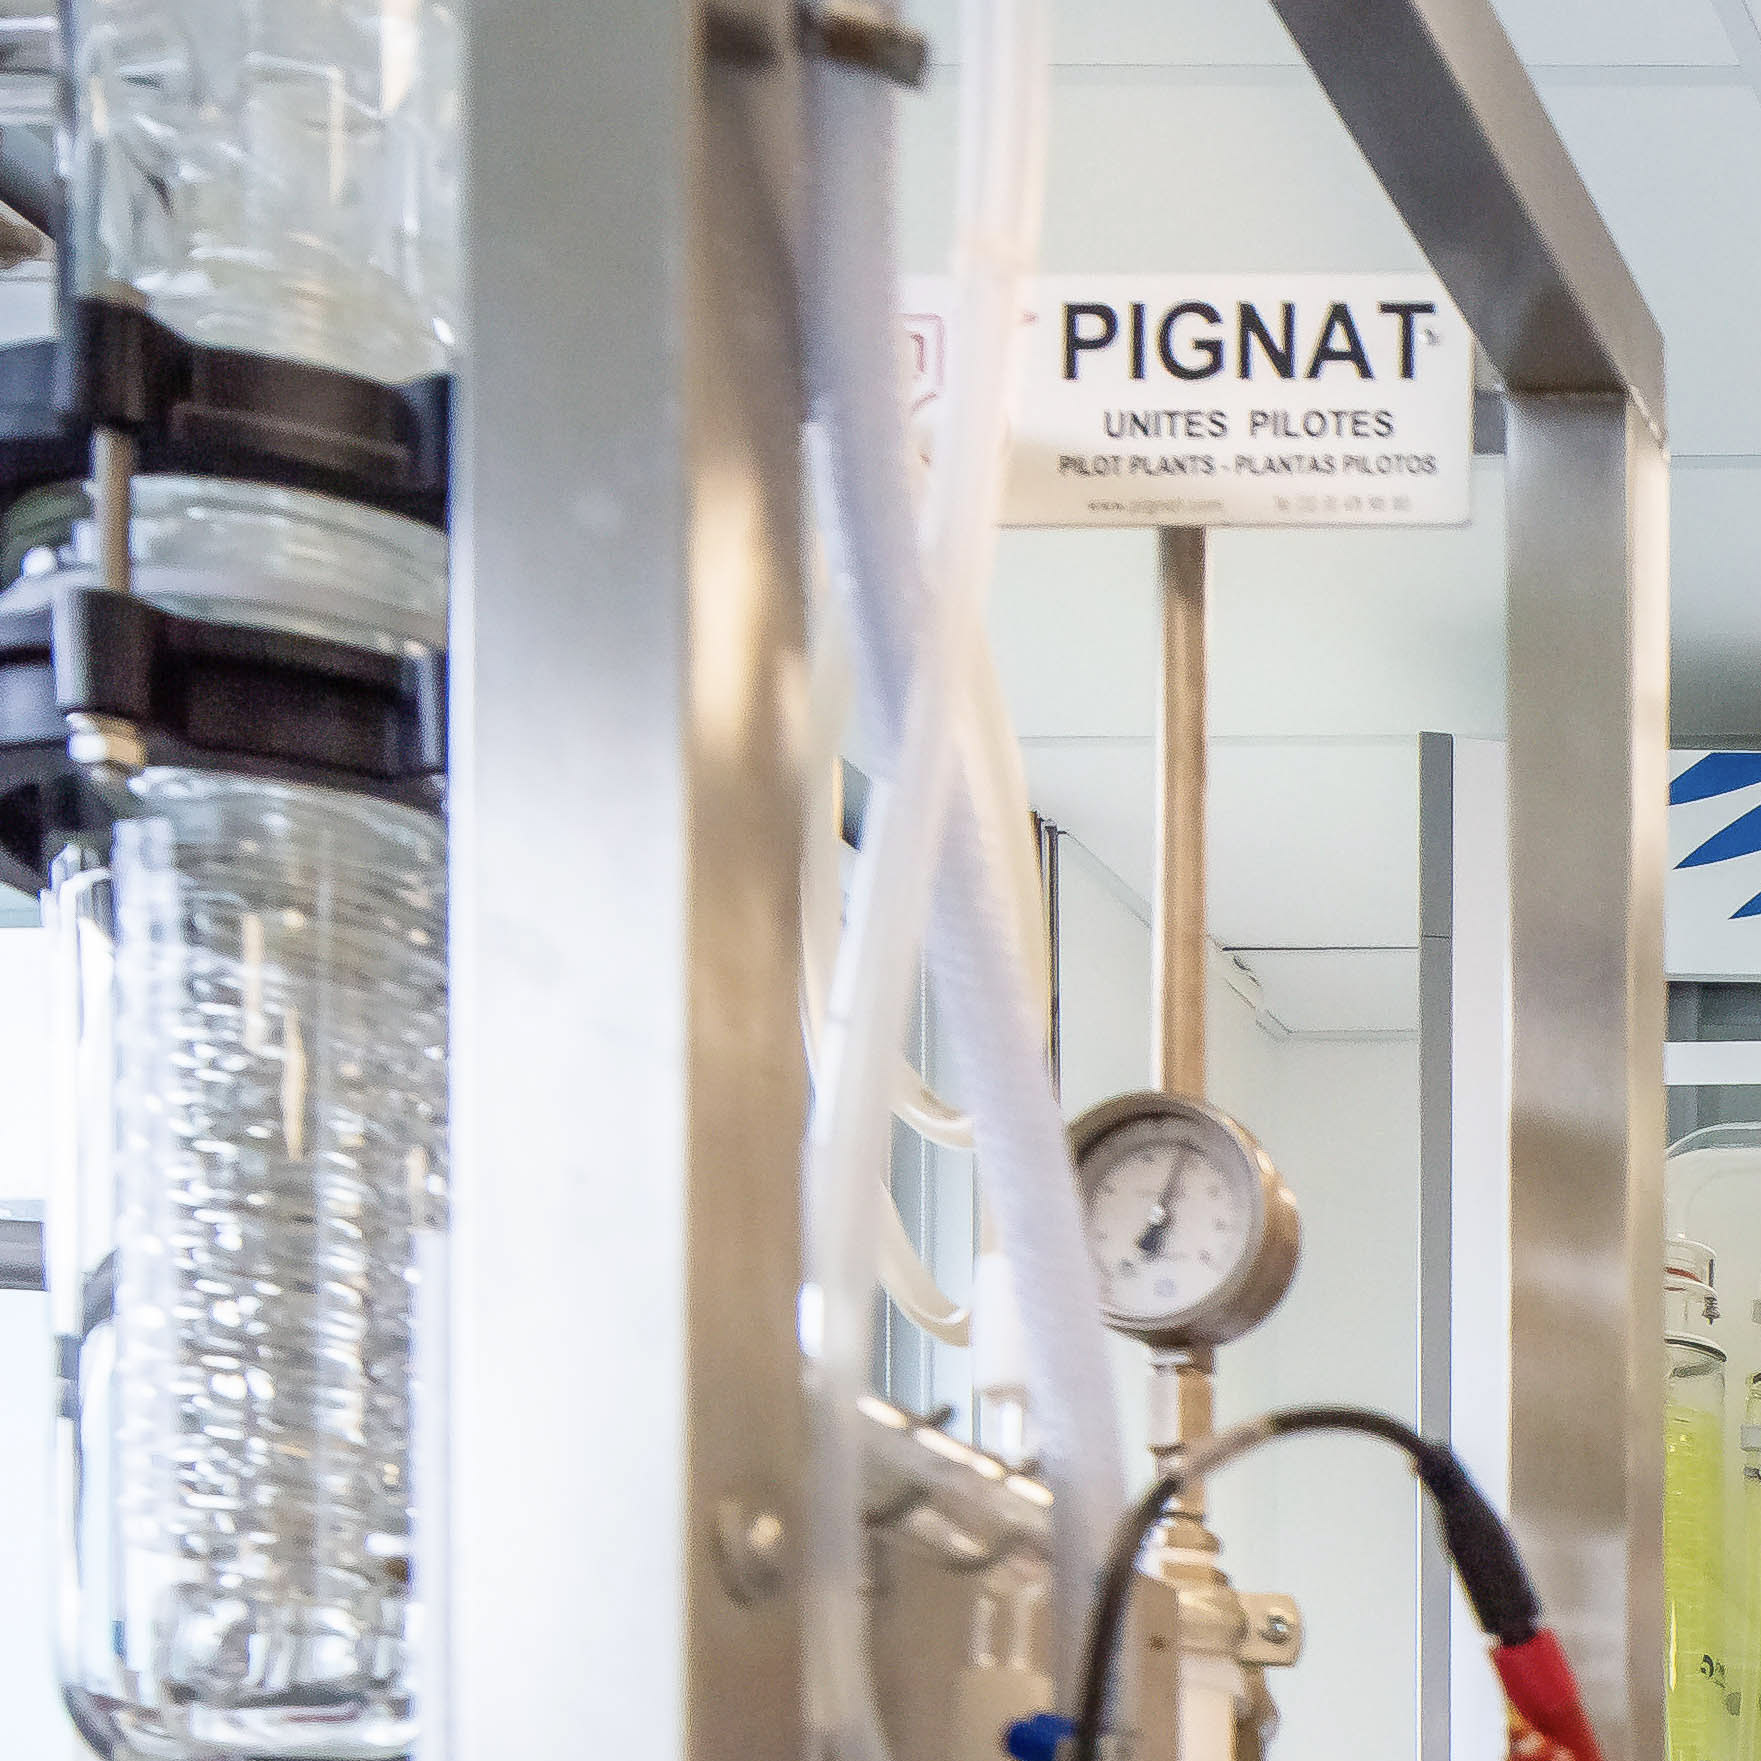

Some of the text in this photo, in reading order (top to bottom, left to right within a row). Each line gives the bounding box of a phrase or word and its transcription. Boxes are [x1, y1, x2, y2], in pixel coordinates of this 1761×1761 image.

[1062, 302, 1436, 380] PIGNAT
[1105, 409, 1394, 439] UNITES PILOTES
[1059, 454, 1121, 476] PILOT
[1130, 454, 1216, 476] PLANTS
[1235, 453, 1336, 475] PLANTAS
[1343, 453, 1437, 475] PILOTOS
